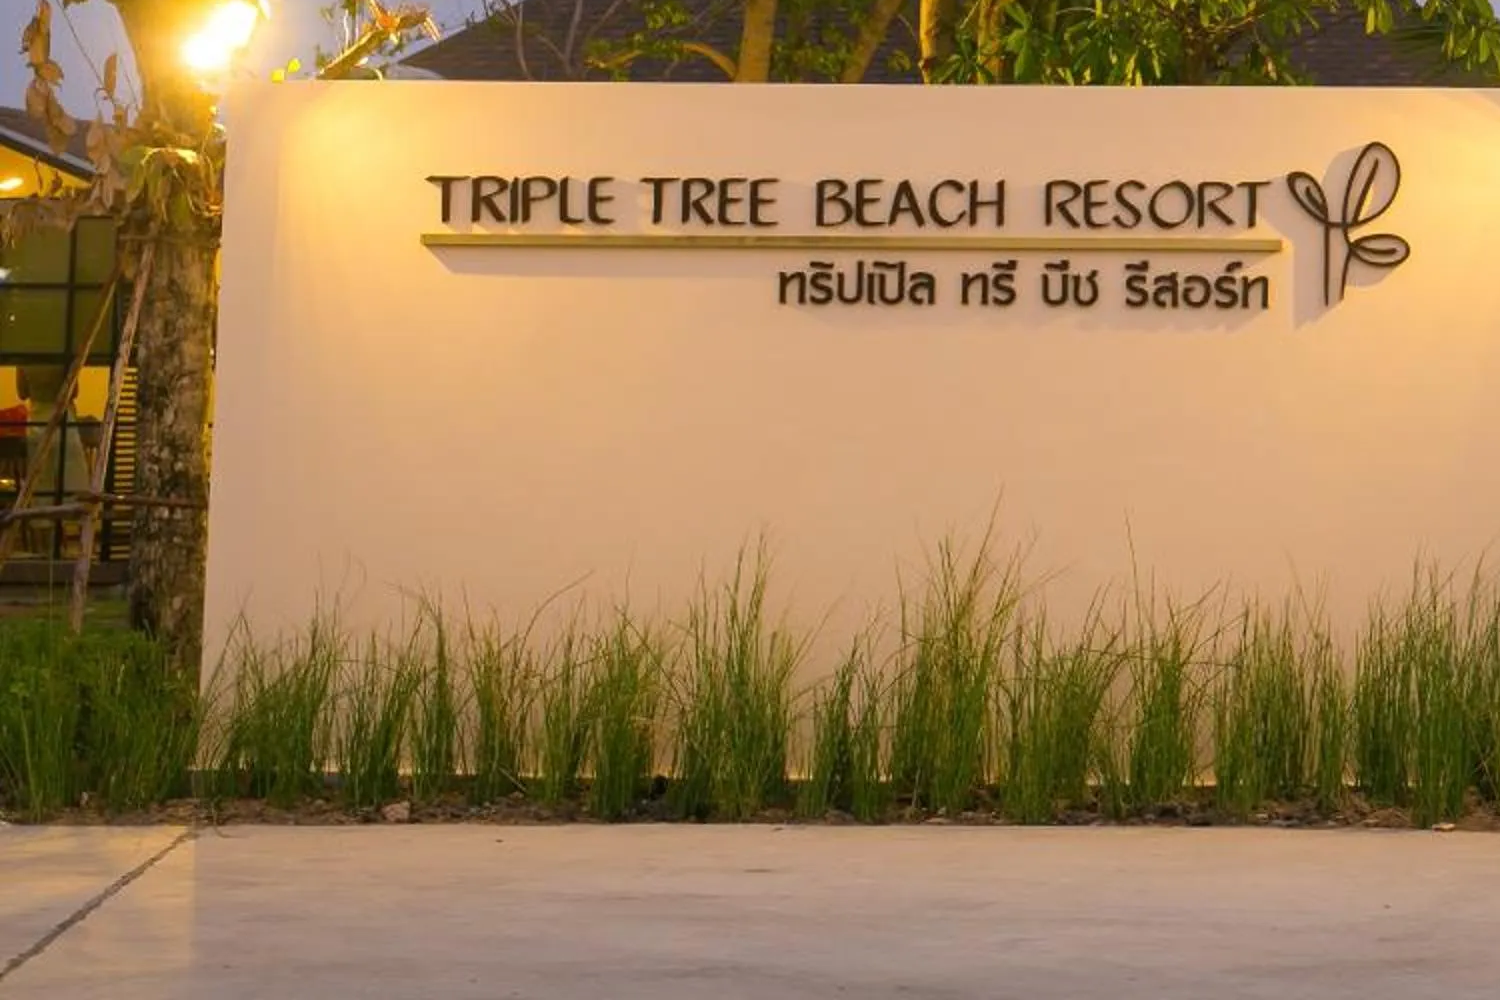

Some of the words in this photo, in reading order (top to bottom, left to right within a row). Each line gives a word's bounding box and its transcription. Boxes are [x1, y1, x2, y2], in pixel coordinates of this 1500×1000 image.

[425, 175, 615, 225] TRIPLE
[640, 177, 779, 227] TREE
[815, 178, 1005, 229] BEACH
[1044, 179, 1271, 230] RESORT
[777, 260, 936, 306] ทริปเปิล
[961, 259, 1018, 307] ทรี
[1041, 259, 1099, 307] บีช
[1124, 260, 1270, 310] รีสอร์ท
